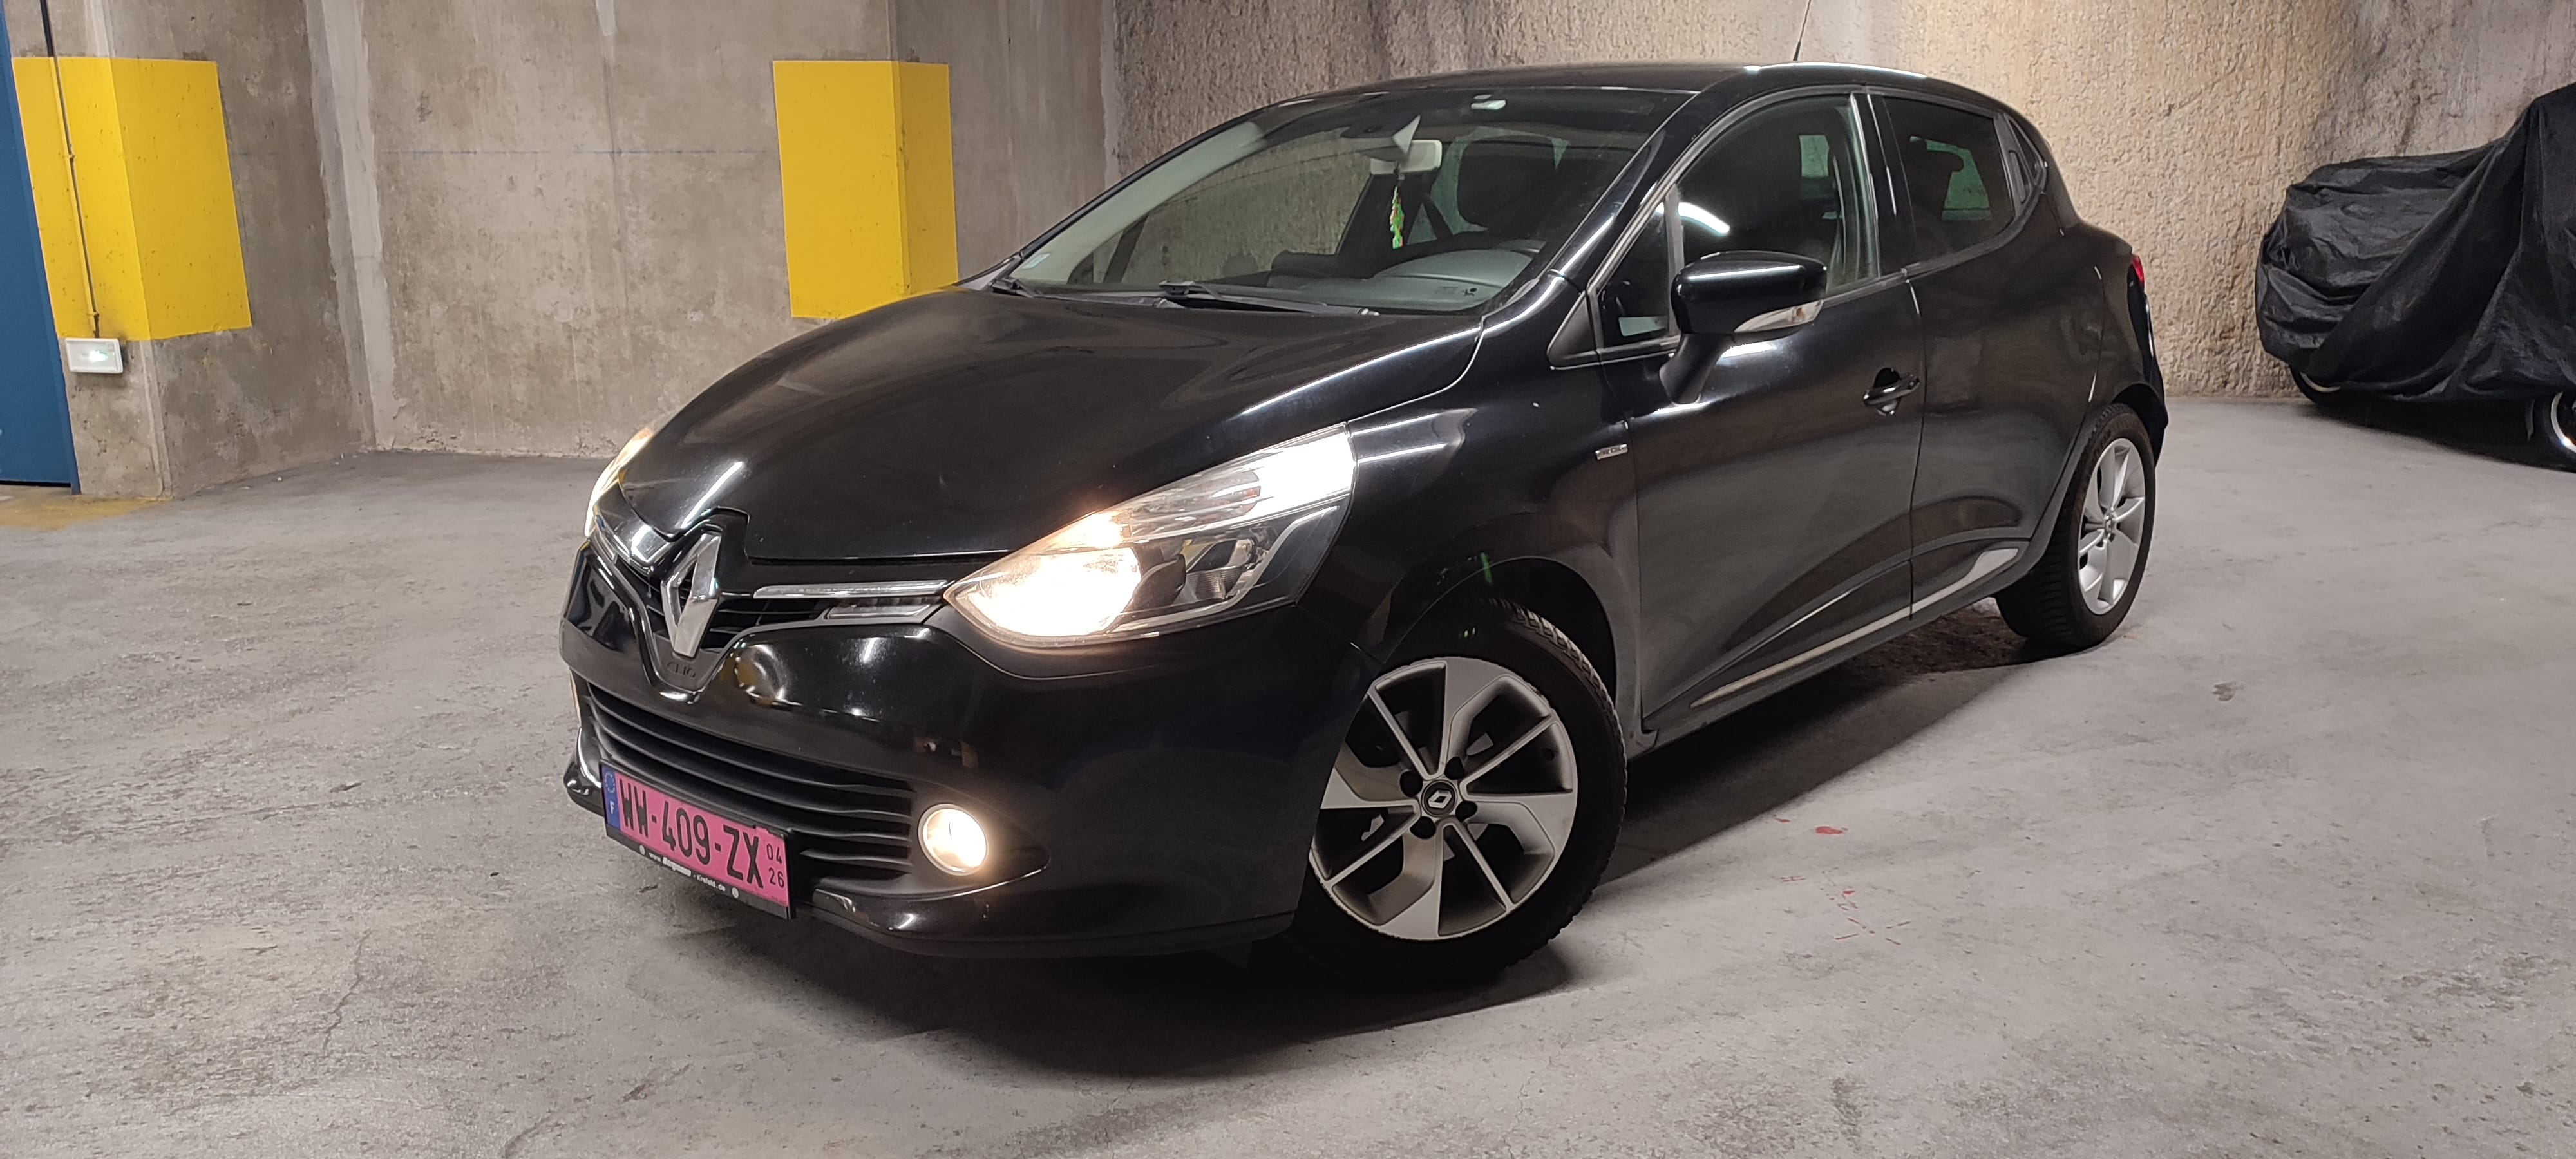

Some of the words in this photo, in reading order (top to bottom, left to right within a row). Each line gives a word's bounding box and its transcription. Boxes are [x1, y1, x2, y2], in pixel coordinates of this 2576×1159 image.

[667, 661, 696, 677] CLIO
[609, 800, 615, 815] F
[619, 777, 764, 889] WW-409-ZX
[766, 843, 782, 865] 04
[768, 867, 784, 888] 26
